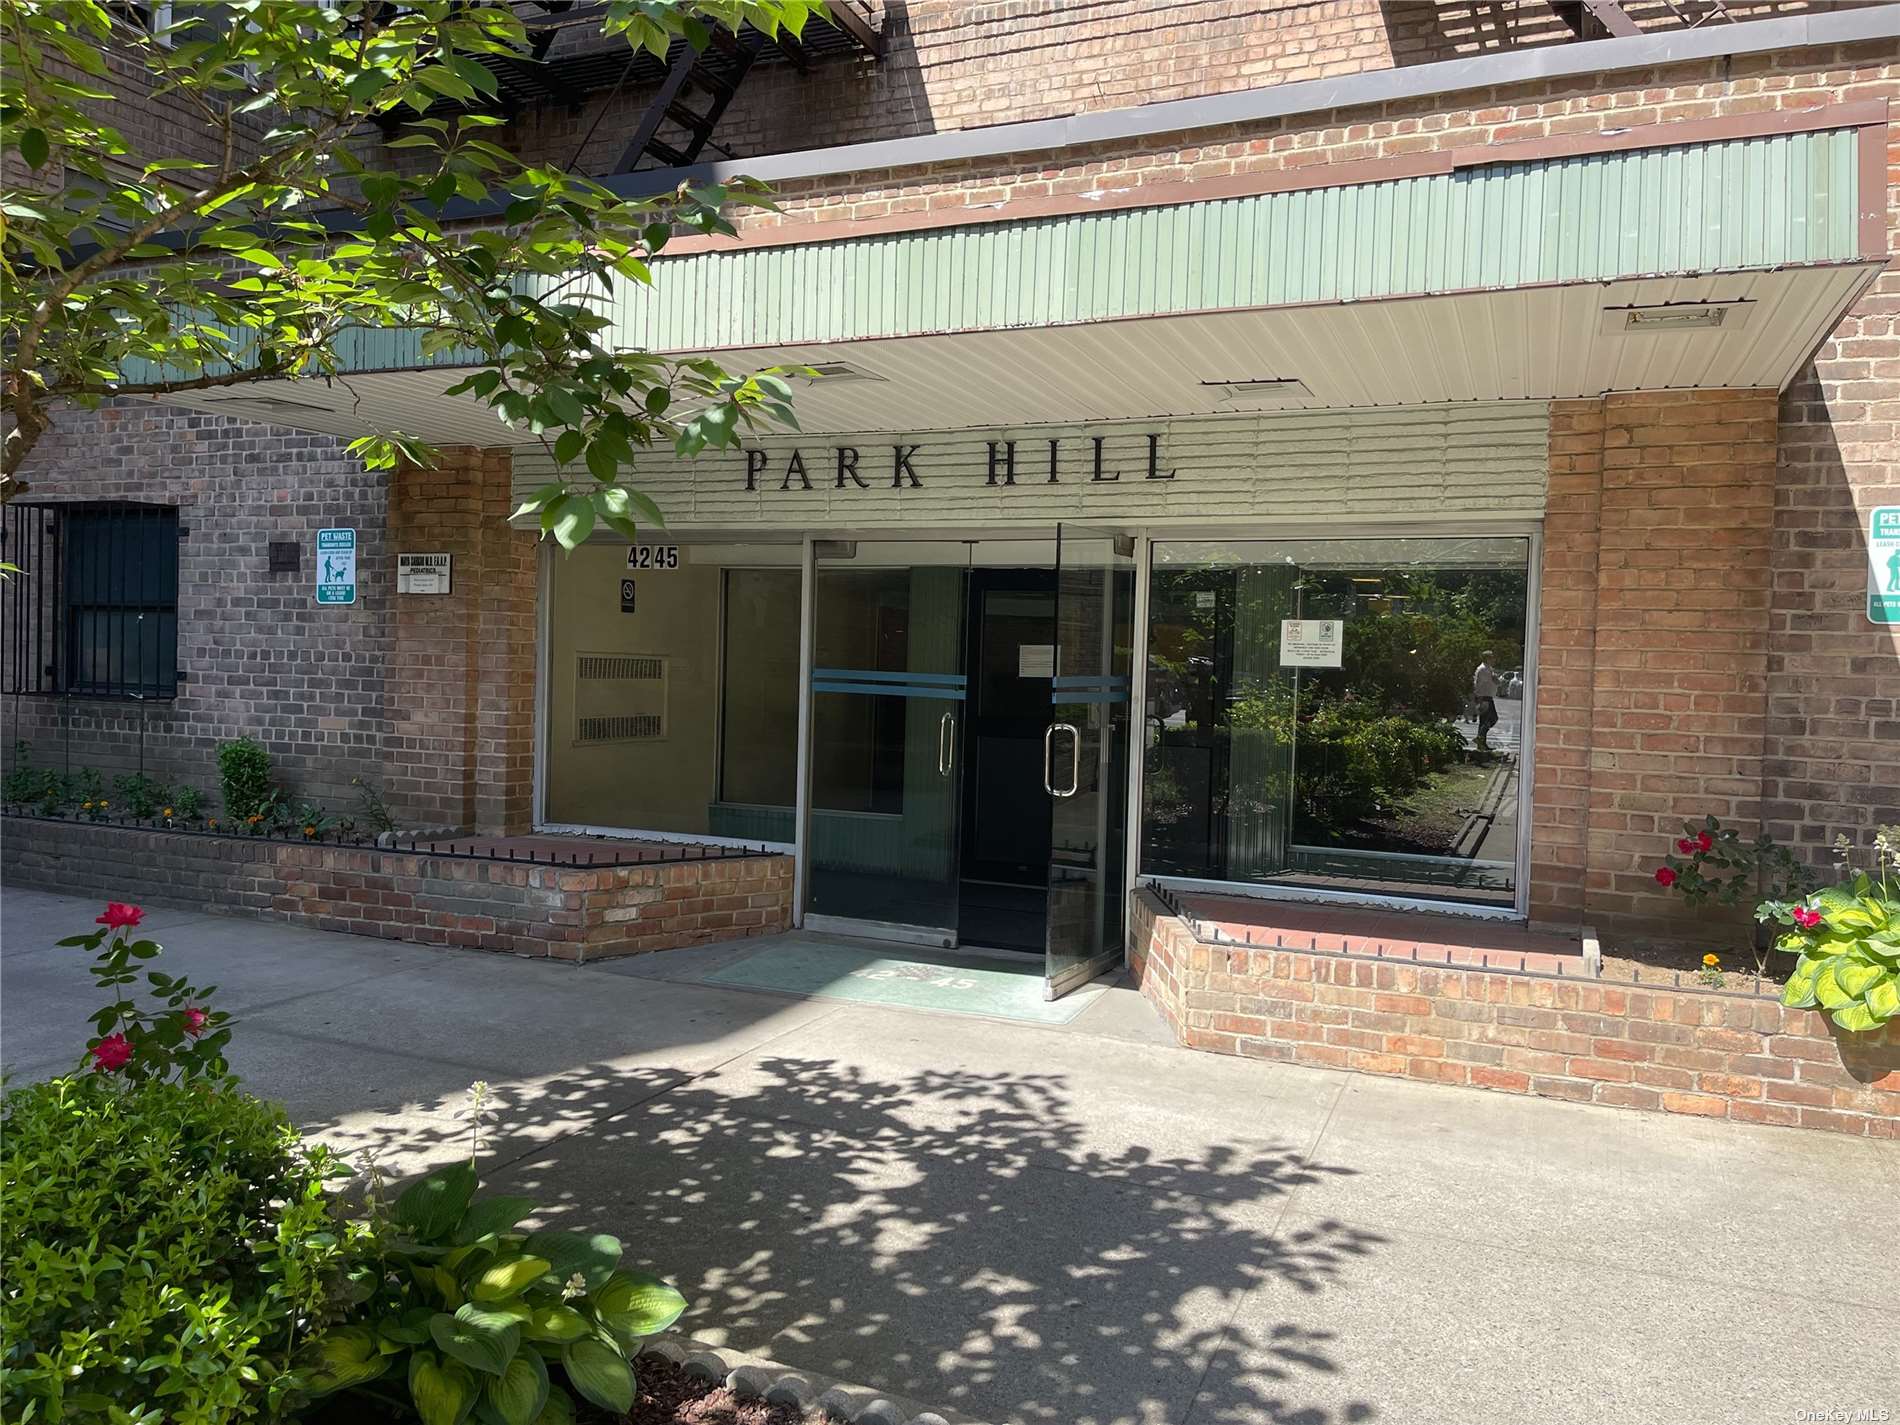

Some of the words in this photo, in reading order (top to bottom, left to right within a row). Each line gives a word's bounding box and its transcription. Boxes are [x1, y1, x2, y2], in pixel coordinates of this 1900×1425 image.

[745, 445, 924, 491] PARK
[986, 433, 1177, 486] HILL
[333, 532, 352, 541] WASTE
[627, 546, 678, 569] 4245
